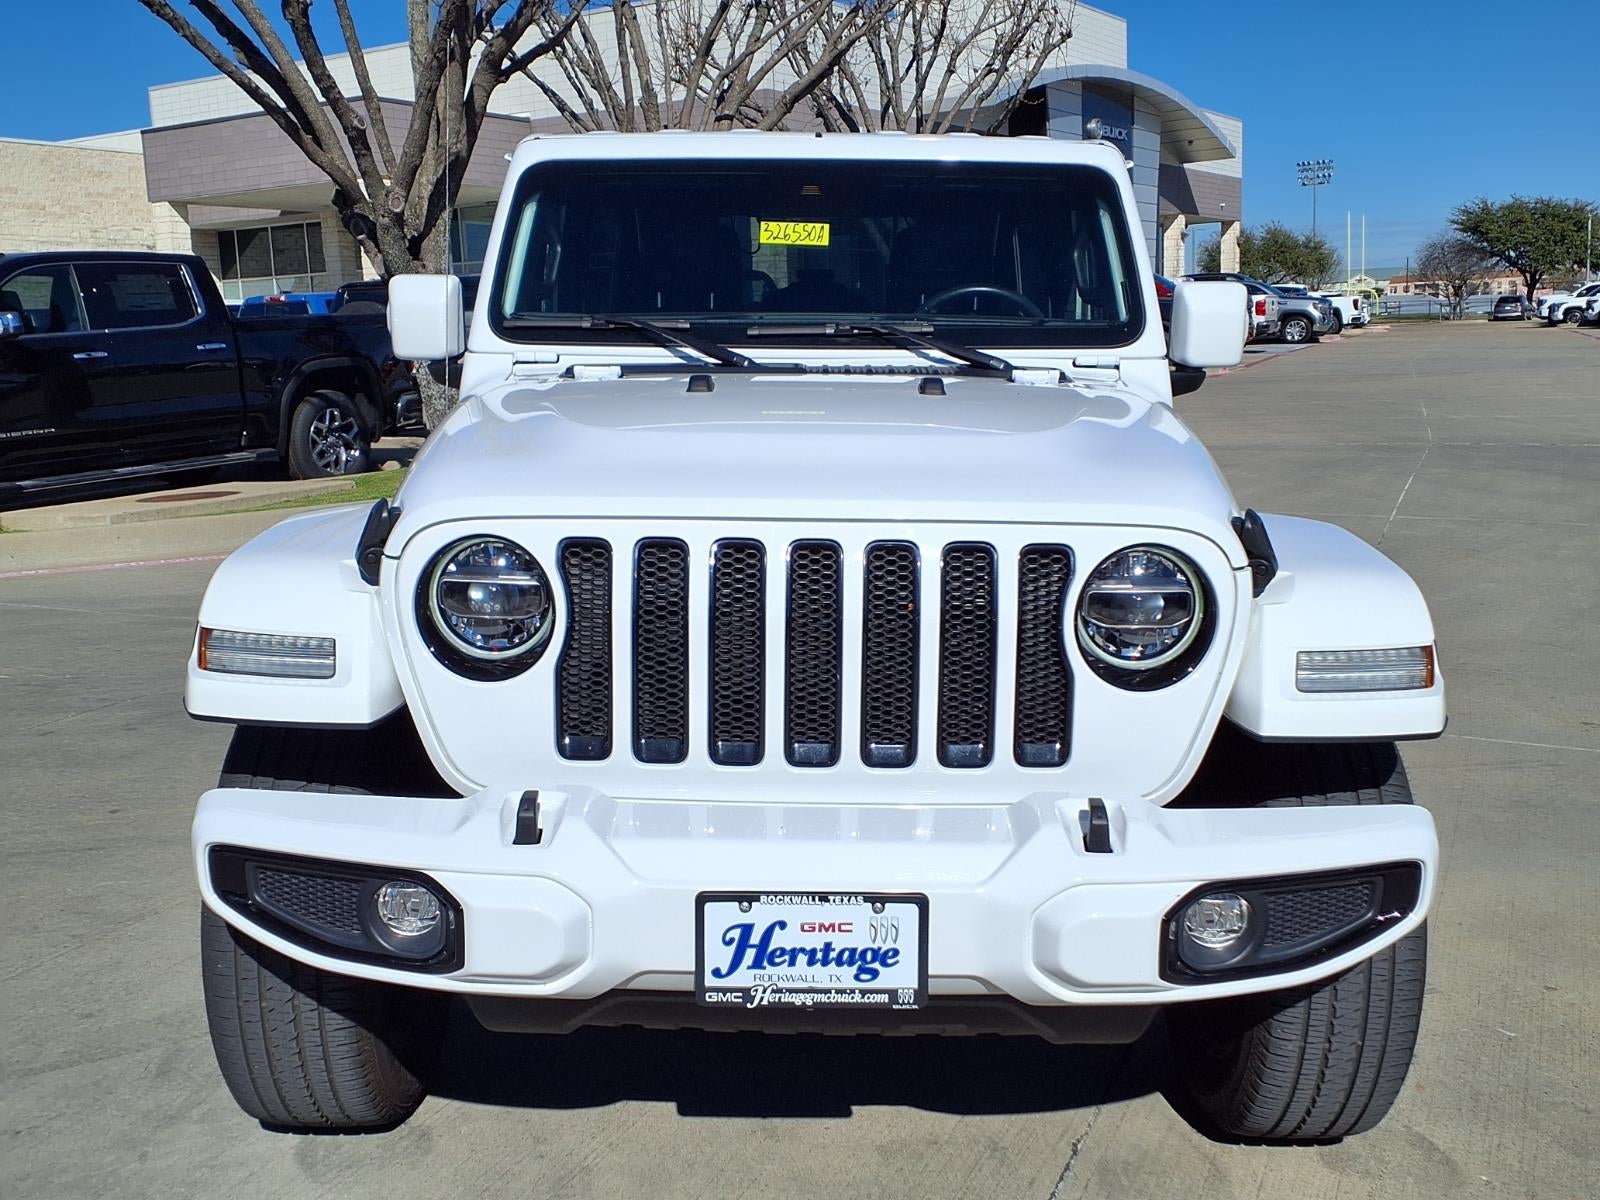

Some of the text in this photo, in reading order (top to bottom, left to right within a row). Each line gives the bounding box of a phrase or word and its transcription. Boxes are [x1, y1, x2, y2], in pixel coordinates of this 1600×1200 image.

[1102, 125, 1128, 140] BUICK
[763, 222, 825, 243] 326550A
[760, 895, 864, 907] ROCKWALL, TEXAS
[800, 922, 853, 933] GMC
[711, 920, 900, 982] Heritage
[753, 973, 842, 984] ROCKWALL, TX
[705, 992, 743, 1002] GMC
[746, 983, 889, 1009] Heritagegmcbuick.com
